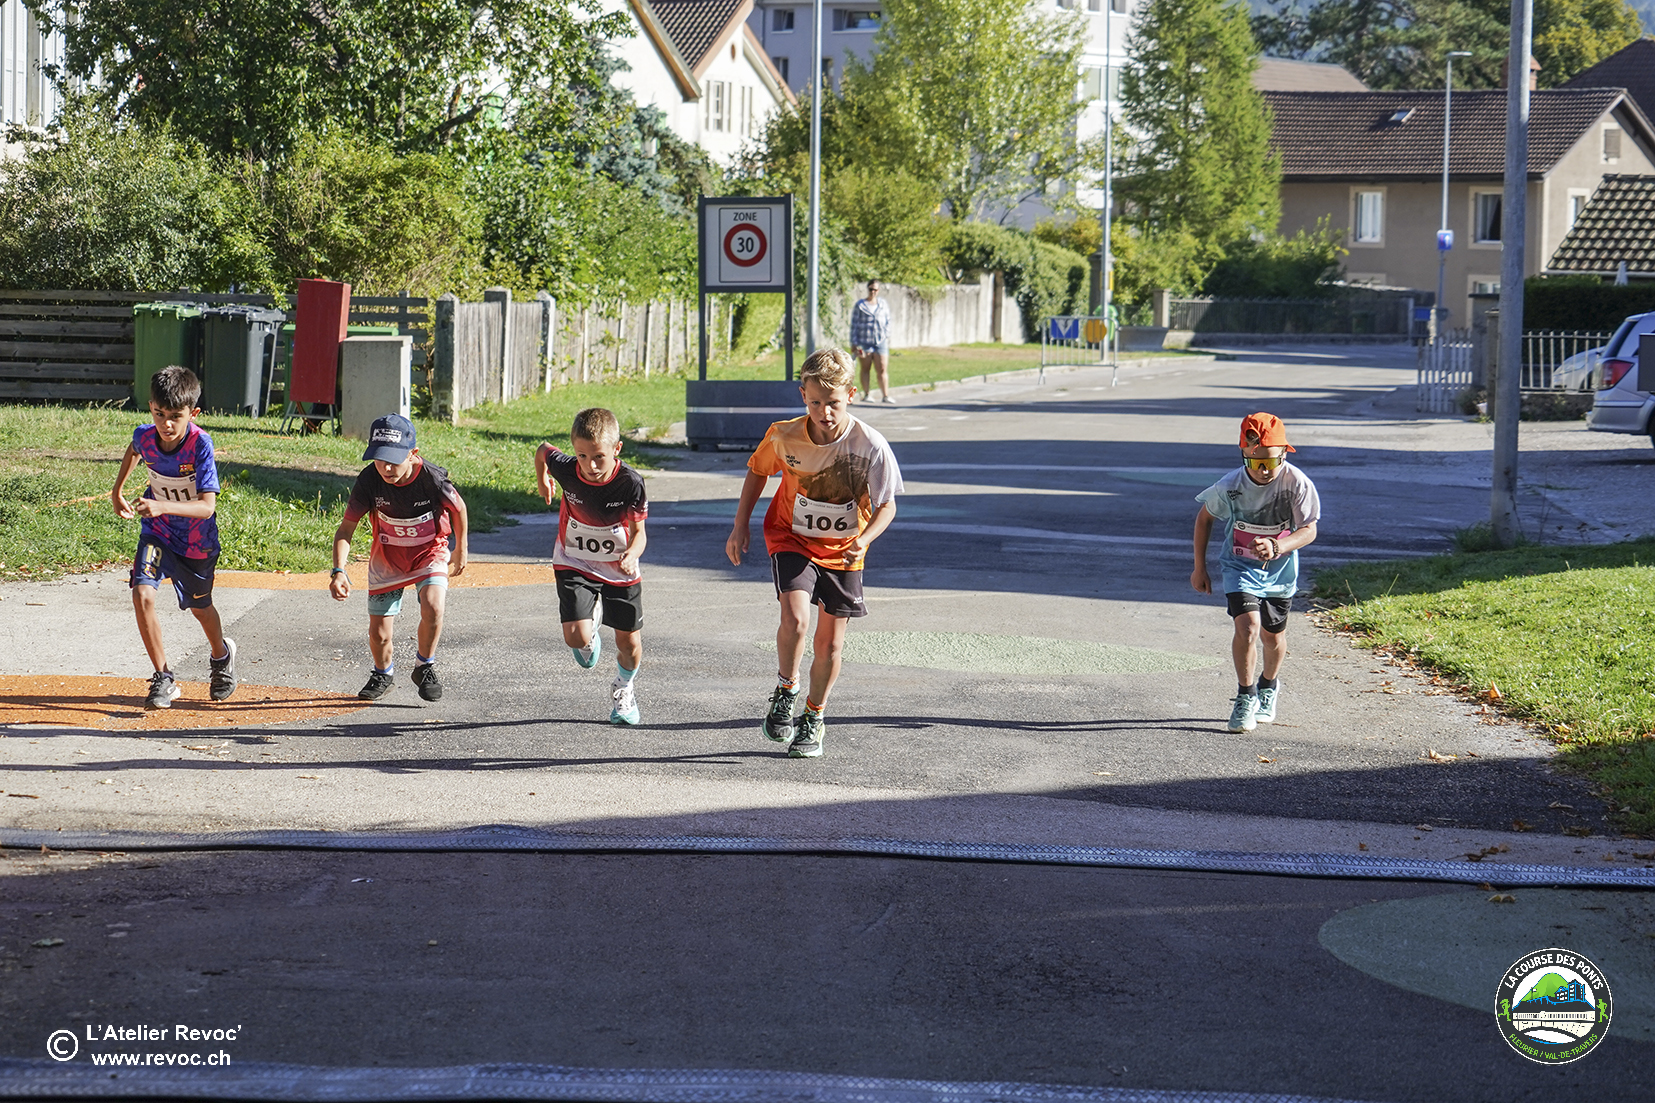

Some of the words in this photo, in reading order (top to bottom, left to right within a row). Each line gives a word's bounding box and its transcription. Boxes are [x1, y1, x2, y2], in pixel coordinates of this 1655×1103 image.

[733, 212, 757, 221] ZONE
[736, 237, 754, 253] 30
[161, 487, 191, 501] 111
[804, 514, 848, 531] 106
[394, 526, 418, 537] 58
[575, 536, 615, 555] 109
[145, 543, 162, 567] 19
